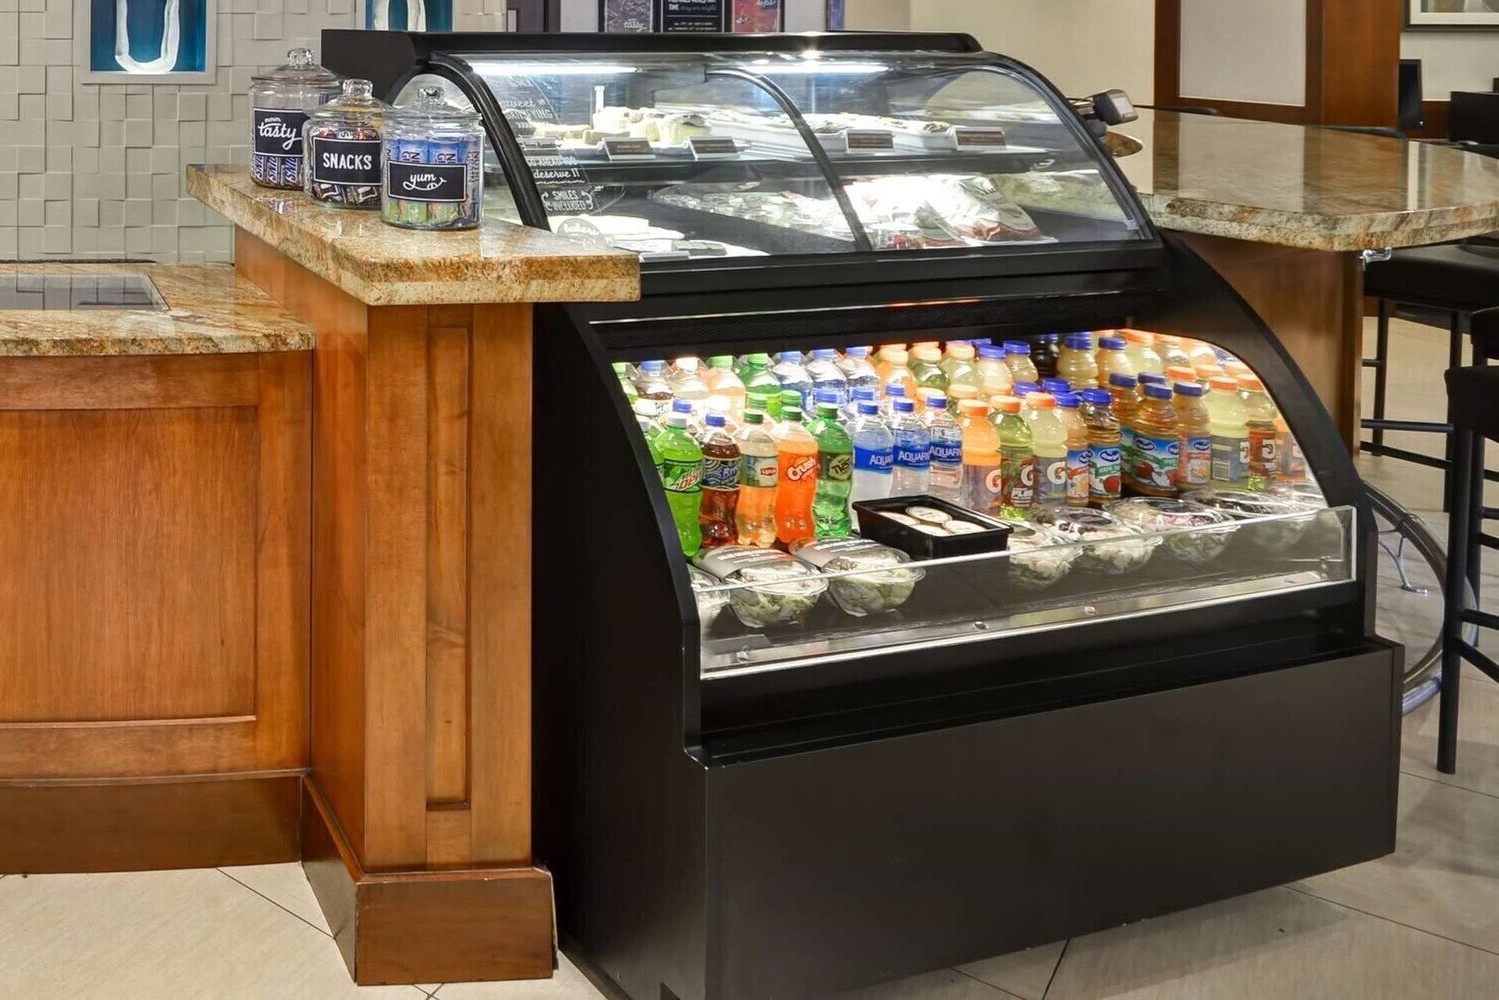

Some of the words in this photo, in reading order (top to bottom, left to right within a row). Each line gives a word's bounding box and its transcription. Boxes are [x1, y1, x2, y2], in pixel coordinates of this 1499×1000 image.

[257, 122, 303, 151] tasty
[323, 152, 372, 170] SNACKS
[402, 173, 437, 191] yum
[533, 168, 571, 179] deserve
[552, 190, 579, 201] SMILES
[552, 200, 587, 211] INCLUDED
[787, 456, 817, 481] Crush
